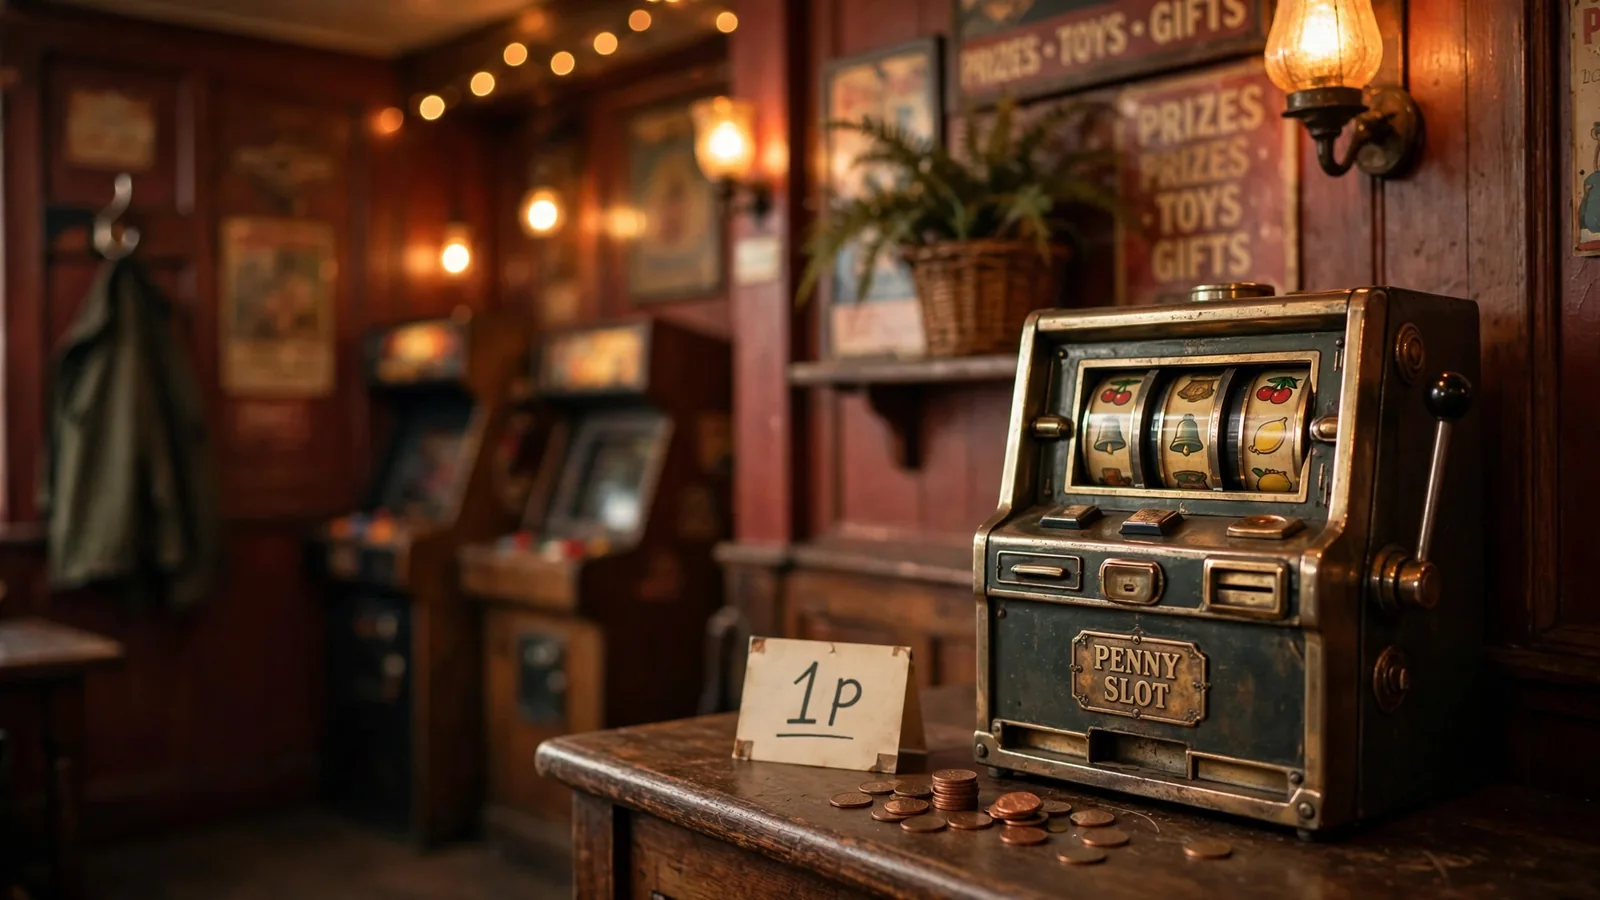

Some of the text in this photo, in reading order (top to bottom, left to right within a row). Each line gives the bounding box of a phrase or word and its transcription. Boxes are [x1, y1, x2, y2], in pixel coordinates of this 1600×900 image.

[961, 0, 1246, 86] PRIZES TOYS GIFTS
[1139, 84, 1264, 146] PRIZES
[1141, 137, 1249, 191] PRIZES
[1156, 183, 1243, 235] TOYS
[1153, 232, 1251, 283] GIFTS
[1094, 644, 1180, 679] PENNY
[1104, 676, 1169, 709] SLOT
